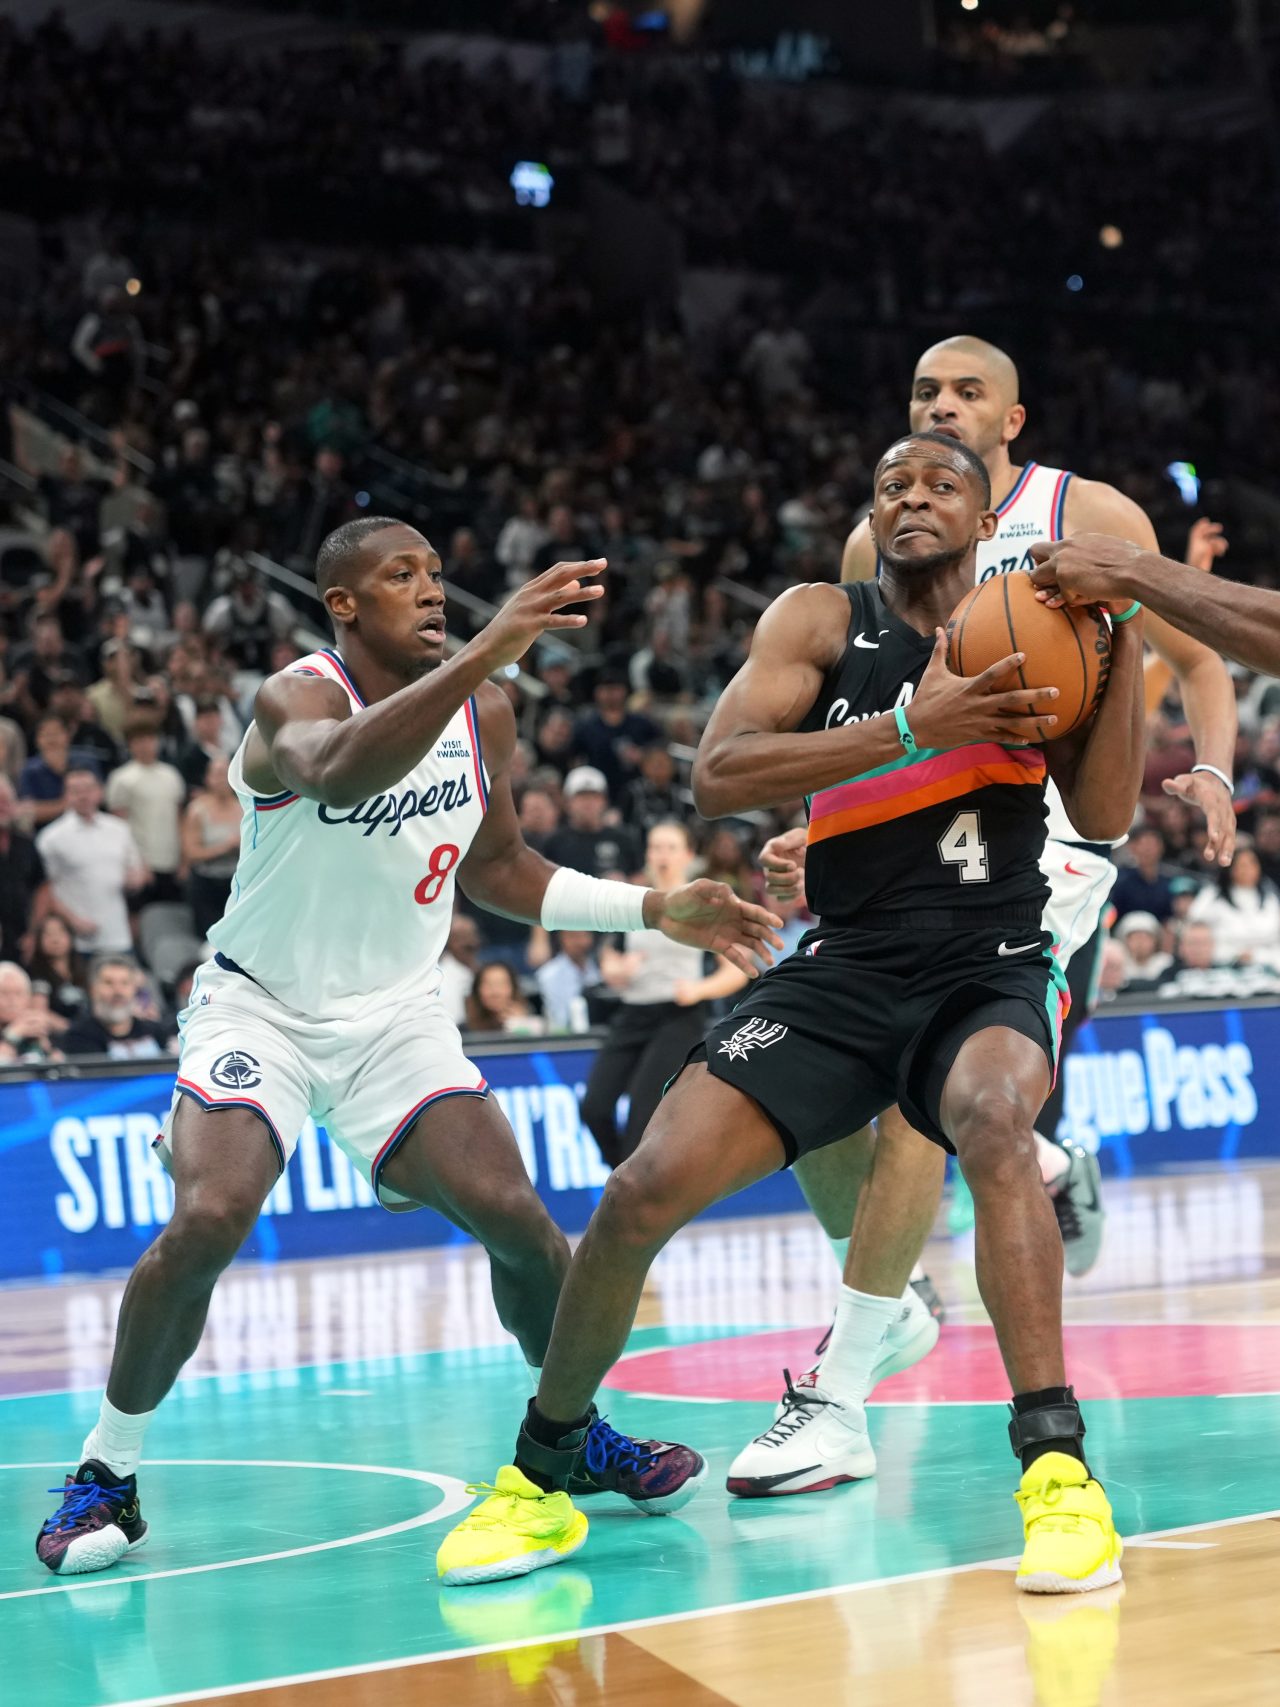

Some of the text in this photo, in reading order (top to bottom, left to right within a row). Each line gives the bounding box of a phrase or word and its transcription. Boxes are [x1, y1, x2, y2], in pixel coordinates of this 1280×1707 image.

[1009, 522, 1034, 530] VISIT
[1000, 529, 1044, 539] RWANDA
[441, 740, 462, 749] VISIT
[436, 749, 470, 758] RWANDA
[937, 809, 990, 884] 4
[414, 843, 460, 905] 8
[1143, 1027, 1258, 1132] Pass
